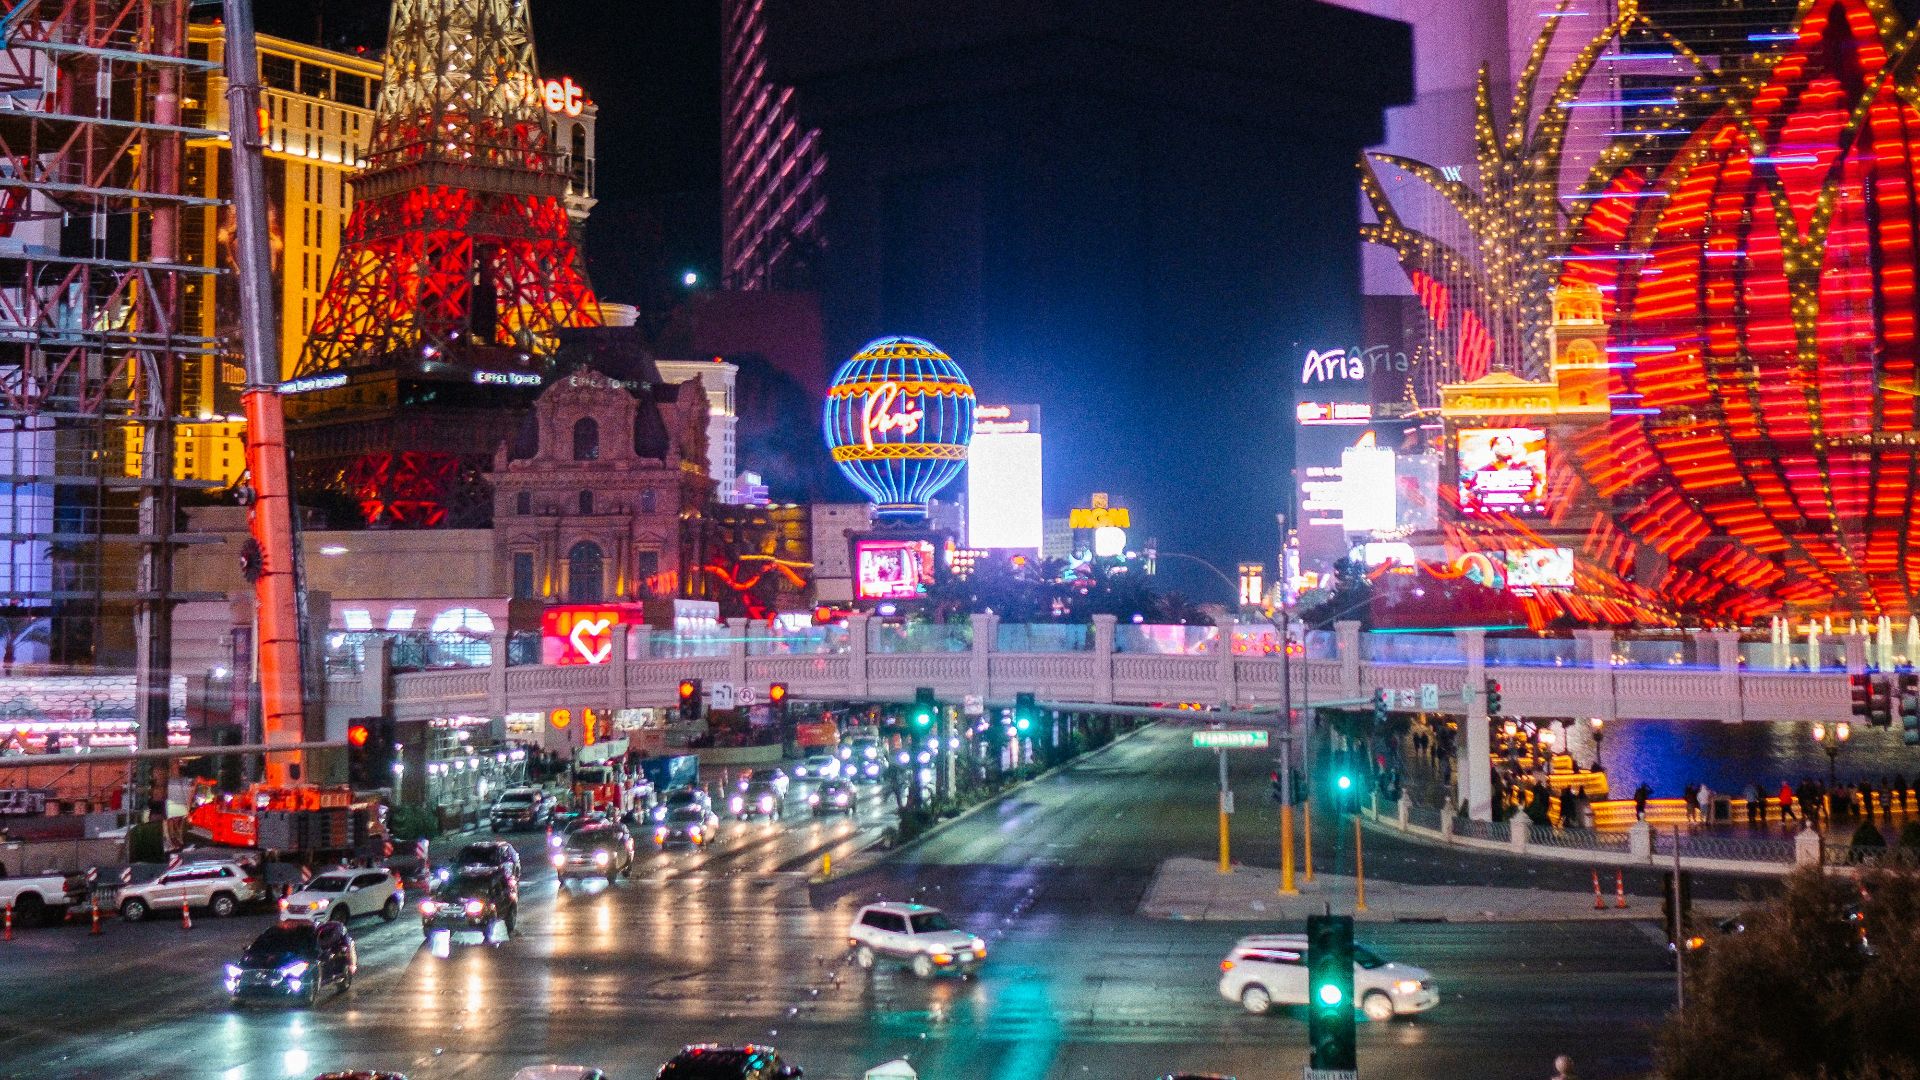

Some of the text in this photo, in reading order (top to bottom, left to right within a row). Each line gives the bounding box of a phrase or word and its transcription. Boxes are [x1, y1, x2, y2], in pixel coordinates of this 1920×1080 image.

[1302, 349, 1365, 383] Aria
[863, 381, 925, 453] Paris
[1069, 507, 1131, 529] MGM
